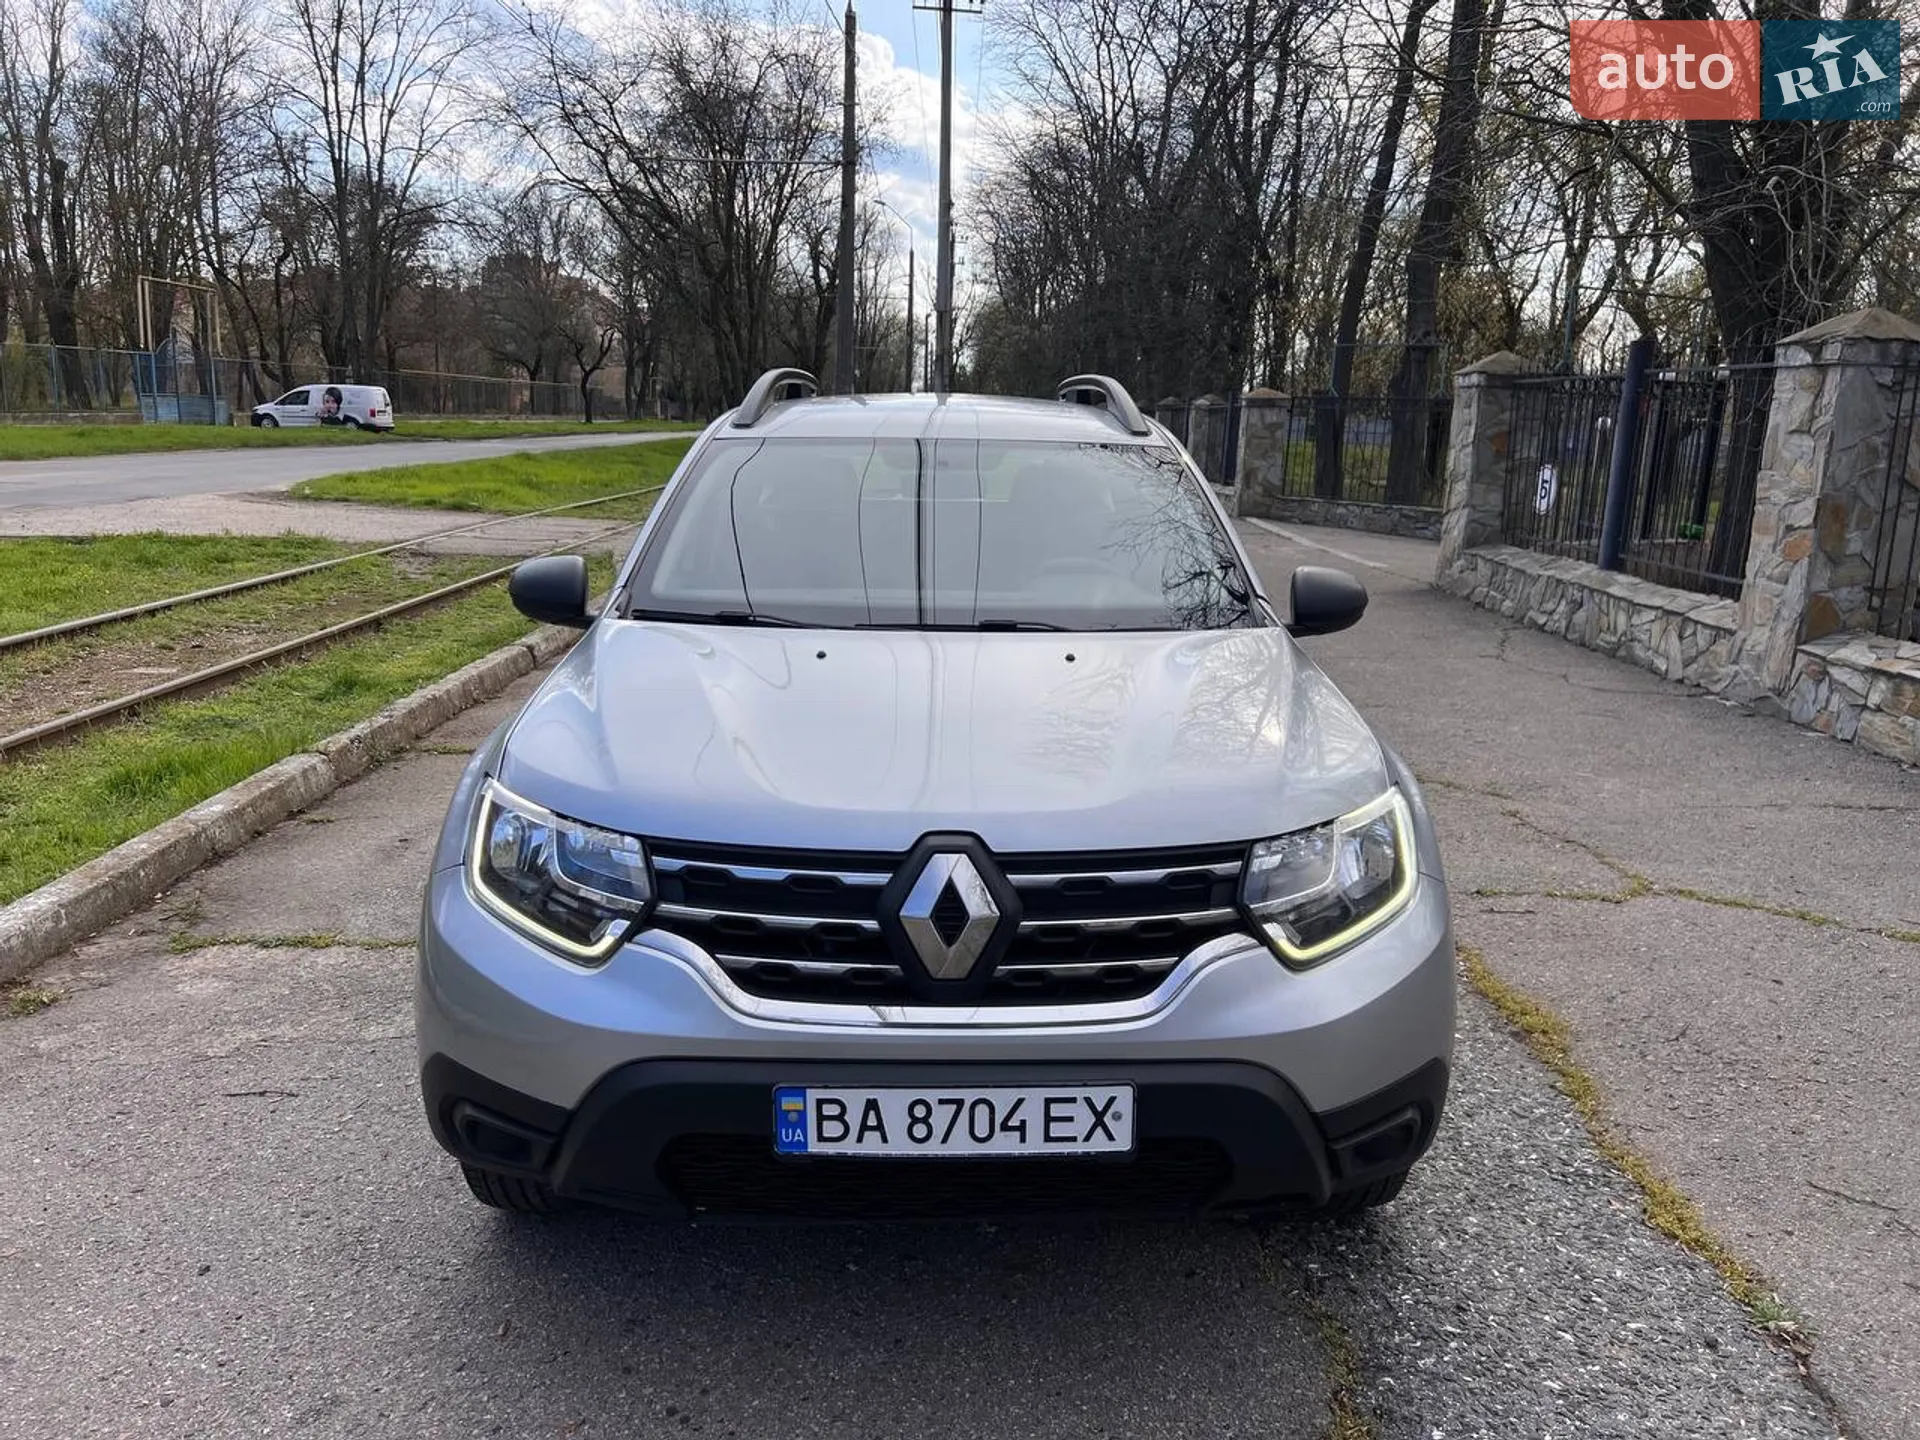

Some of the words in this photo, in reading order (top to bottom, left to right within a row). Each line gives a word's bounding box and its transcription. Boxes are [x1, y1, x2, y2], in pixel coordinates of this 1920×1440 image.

[781, 1127, 805, 1143] UA
[815, 1097, 890, 1144] BA
[907, 1097, 1027, 1145] 8704
[1043, 1096, 1118, 1143] EX
